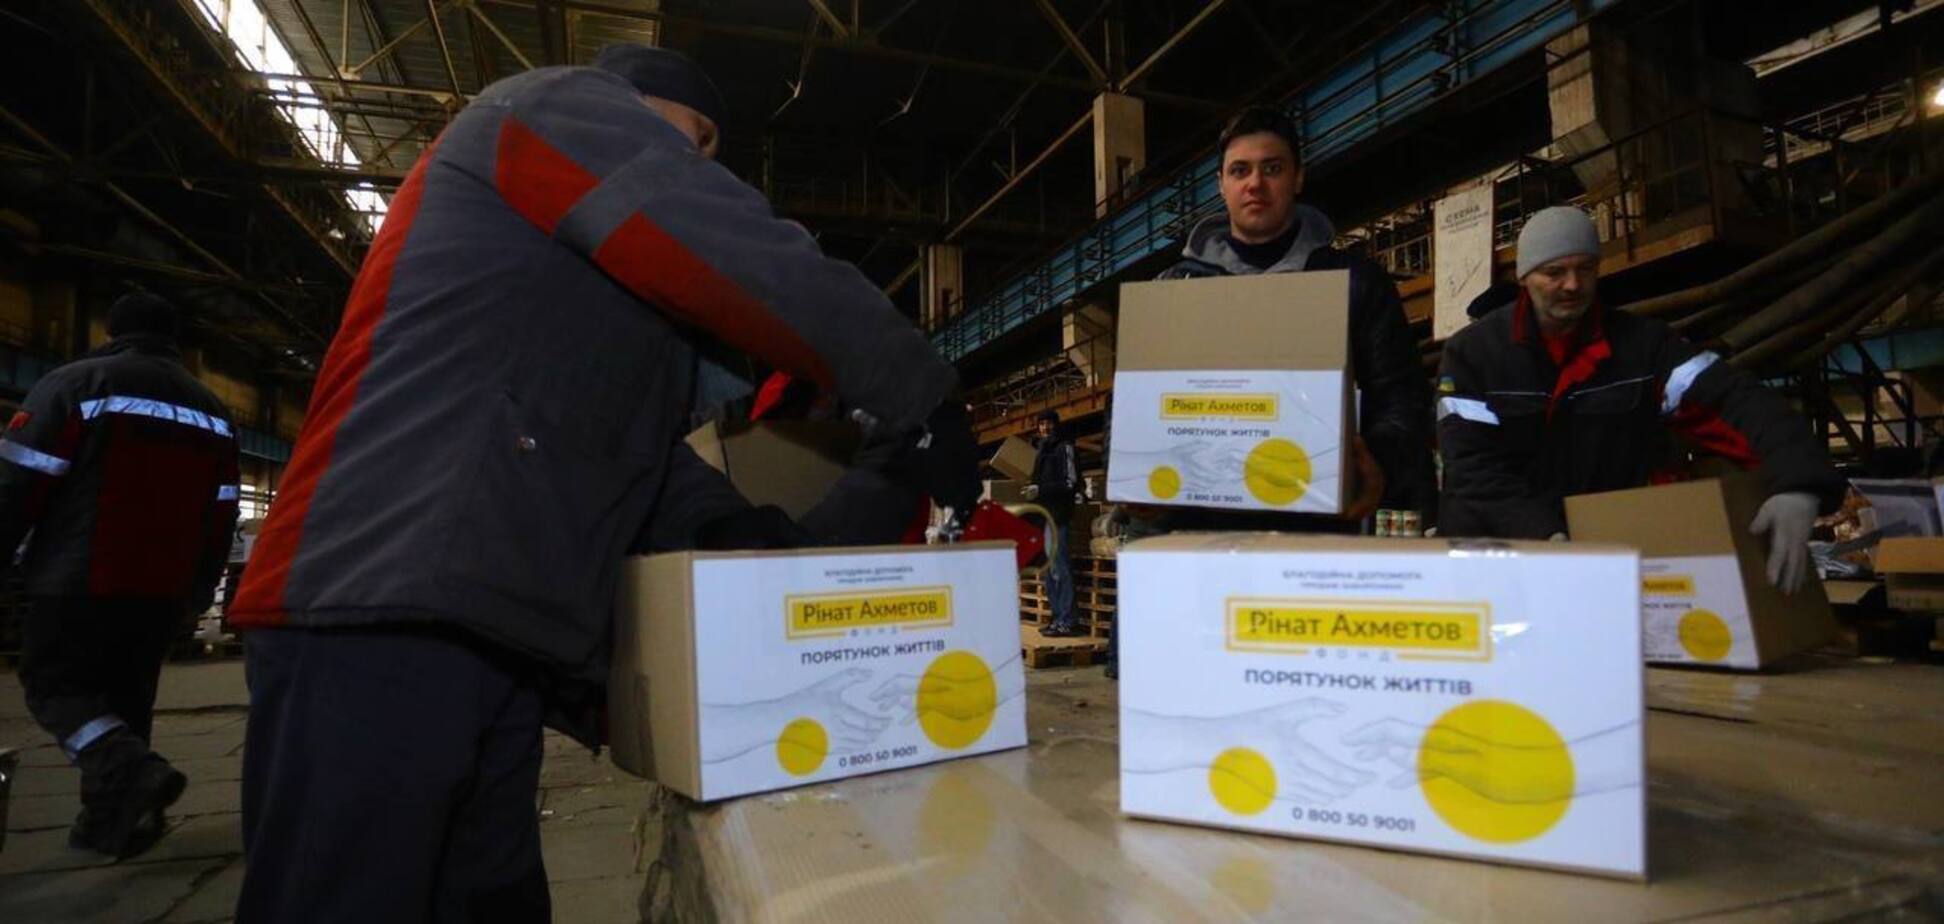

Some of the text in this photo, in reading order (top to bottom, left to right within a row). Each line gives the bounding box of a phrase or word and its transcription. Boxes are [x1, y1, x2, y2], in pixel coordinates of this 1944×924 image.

[1208, 399, 1267, 413] Ахметов
[803, 600, 938, 623] Рінат Ахметов
[1249, 610, 1462, 641] Рінат Ахметов
[801, 639, 945, 665] ПОРЯТУНОК ЖИТТІВ
[1244, 668, 1473, 696] ПОРЯТУНОК ЖИТТІВ
[839, 757, 847, 767] 0
[850, 753, 872, 766] 800
[1292, 807, 1416, 832] 0 800 50 9001
